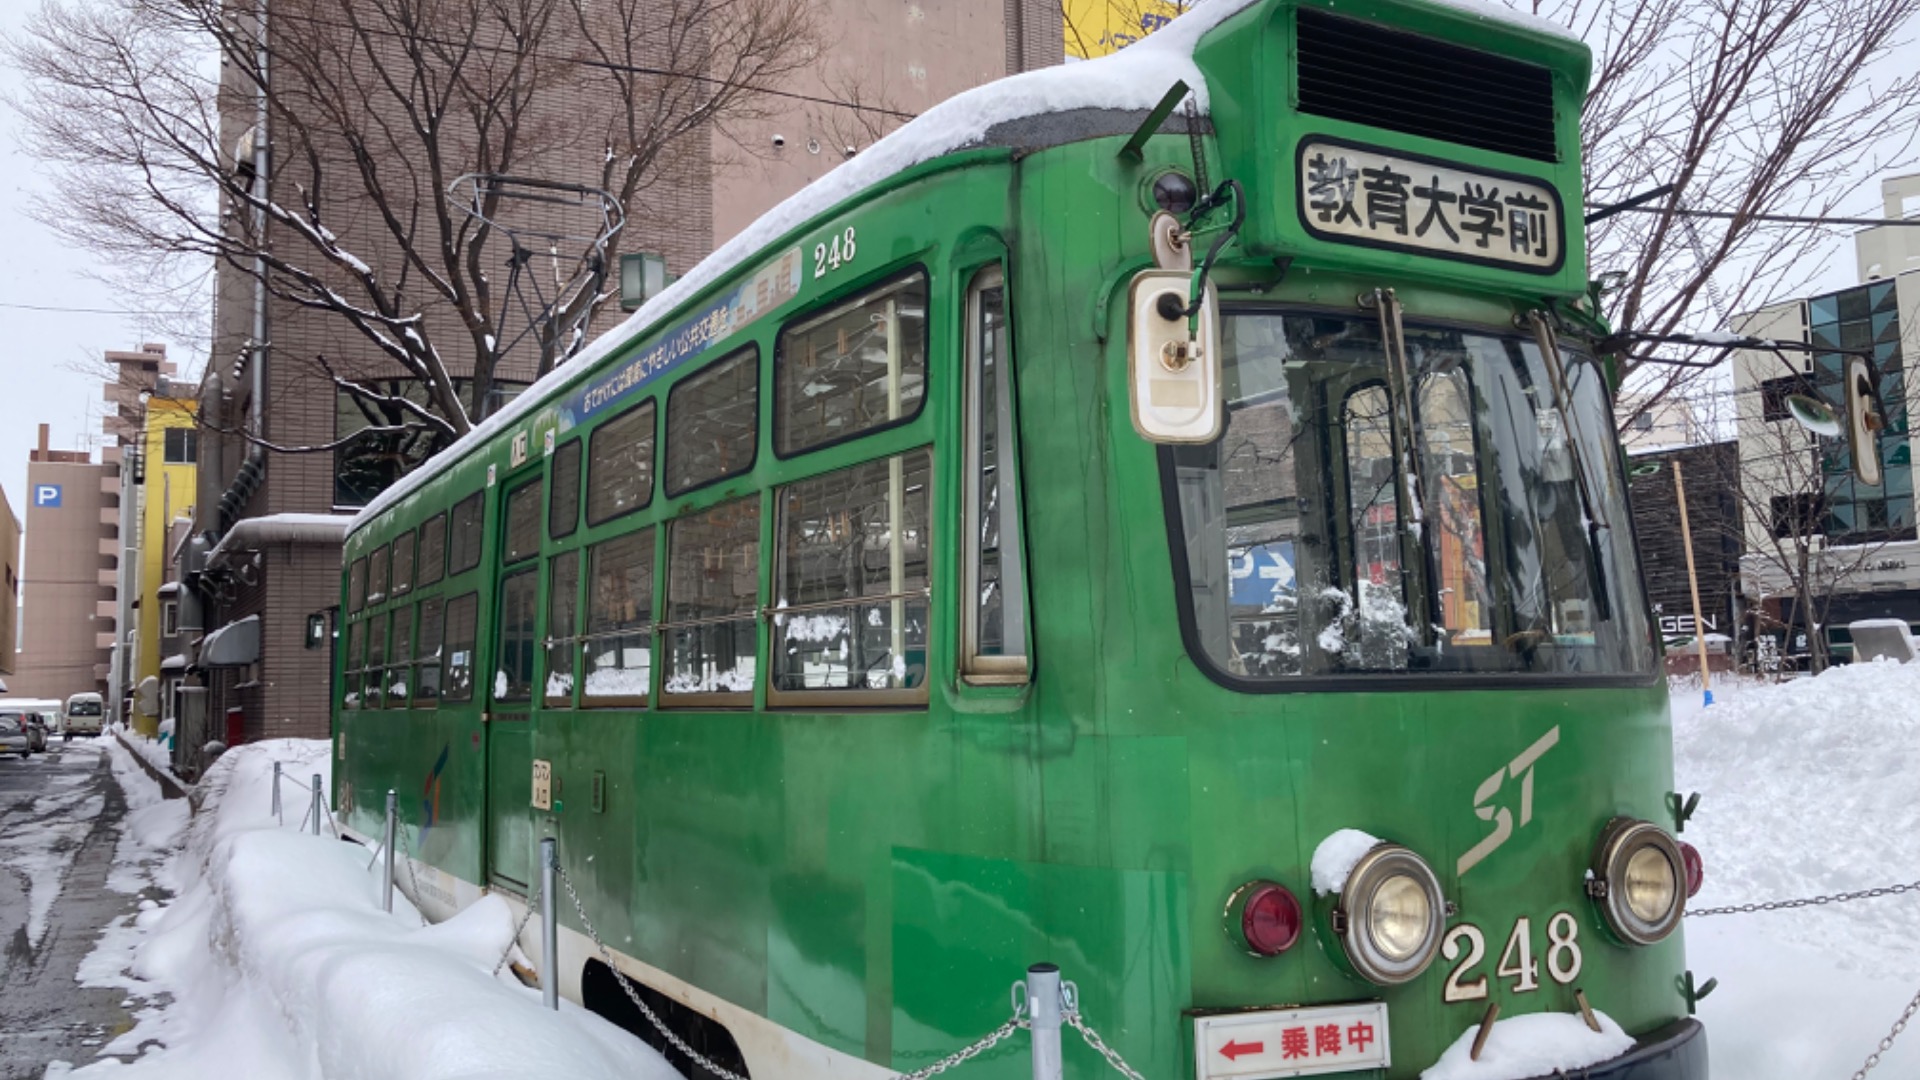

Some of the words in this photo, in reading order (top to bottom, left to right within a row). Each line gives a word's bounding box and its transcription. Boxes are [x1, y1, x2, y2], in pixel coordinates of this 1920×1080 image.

[1308, 152, 1549, 258] 教育大学前
[814, 225, 857, 279] 248
[38, 486, 58, 505] P
[1227, 546, 1254, 598] P
[1457, 724, 1560, 877] ST
[1441, 910, 1583, 1004] 248
[1280, 1020, 1375, 1060] 乗降中
